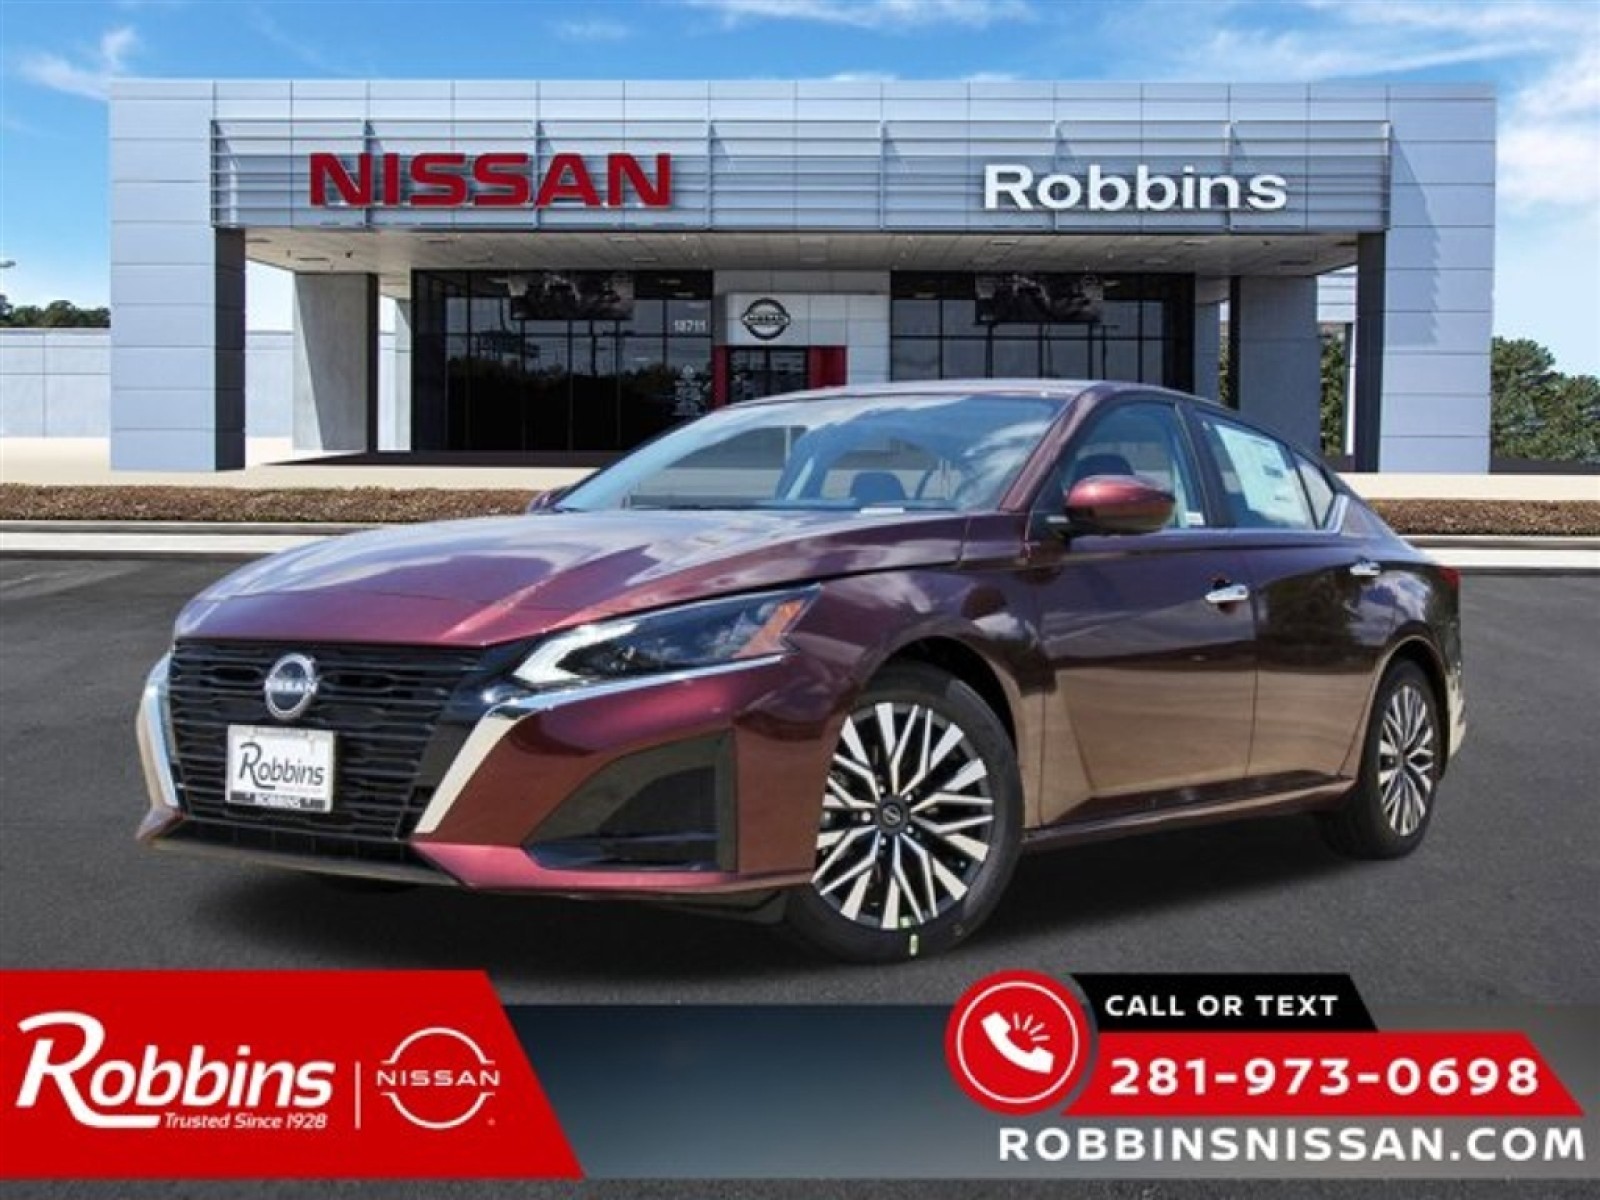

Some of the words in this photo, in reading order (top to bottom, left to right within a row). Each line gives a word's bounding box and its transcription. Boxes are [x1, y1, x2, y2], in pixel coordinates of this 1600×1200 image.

[309, 152, 672, 208] NISSAN
[984, 164, 1288, 211] Robbins
[265, 679, 318, 694] SSAN
[239, 741, 325, 791] Robbins
